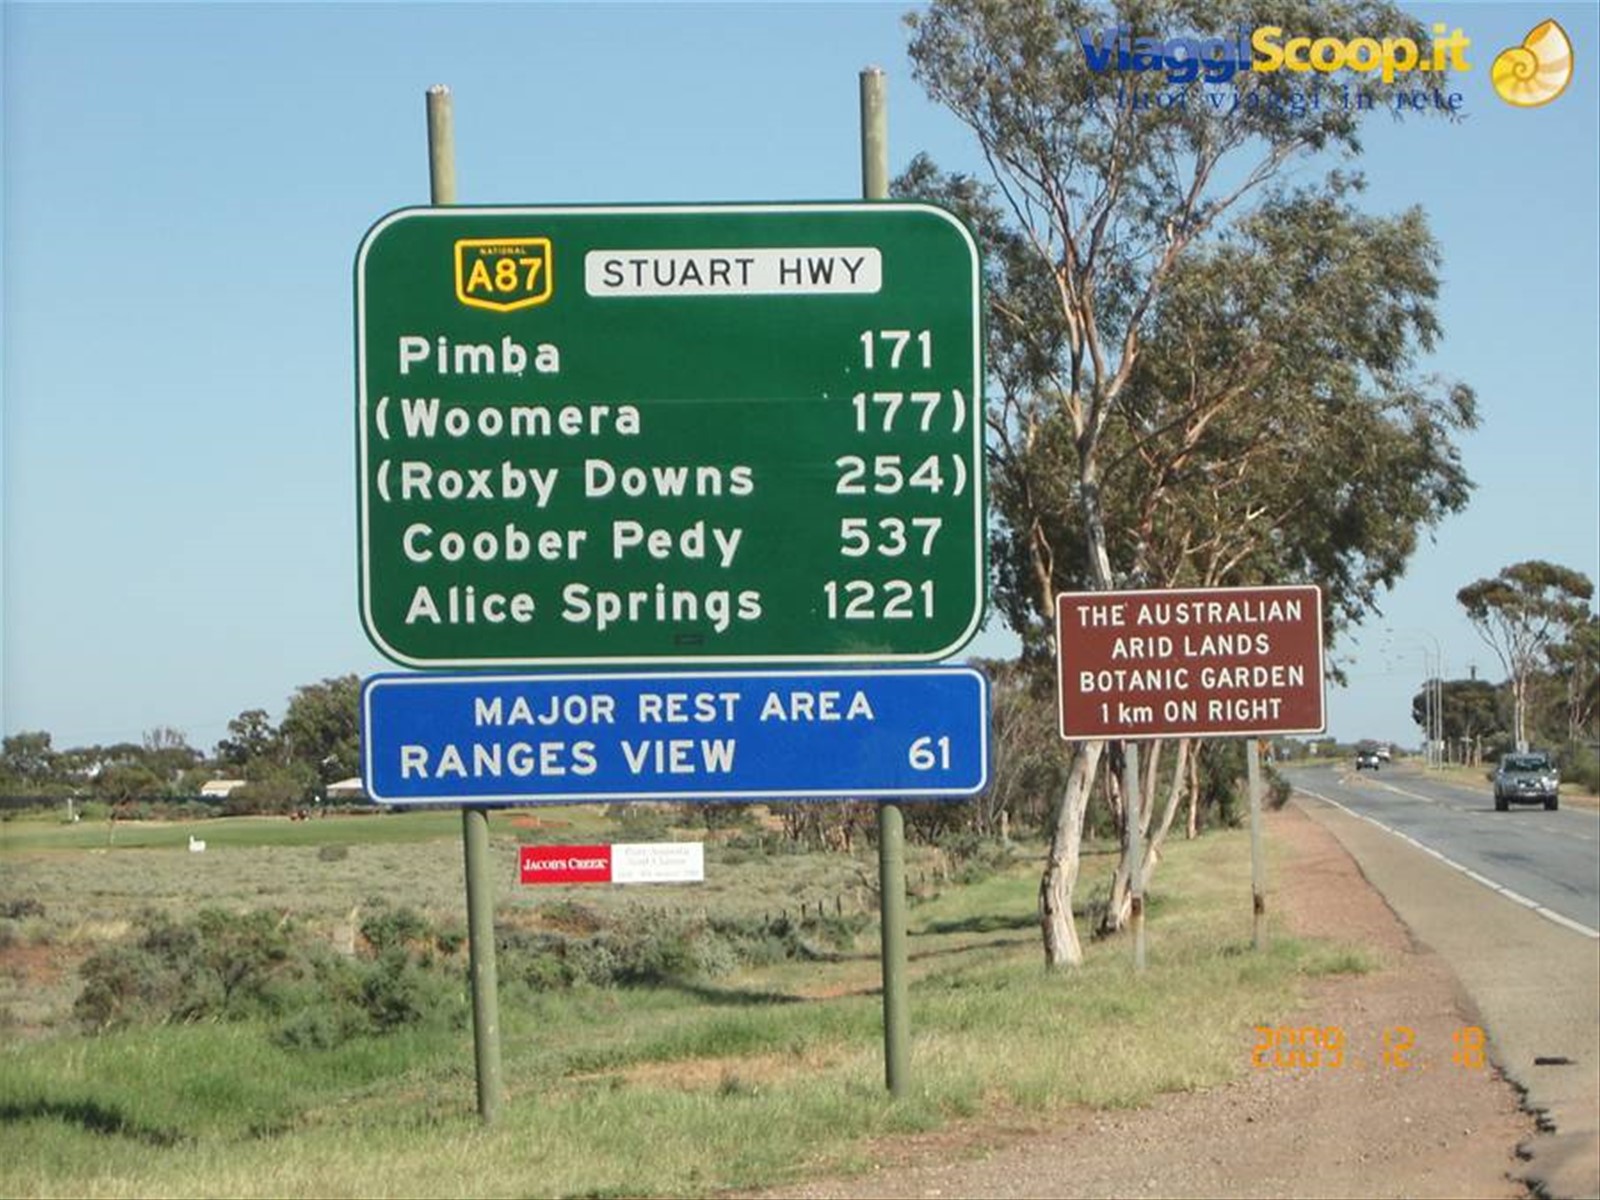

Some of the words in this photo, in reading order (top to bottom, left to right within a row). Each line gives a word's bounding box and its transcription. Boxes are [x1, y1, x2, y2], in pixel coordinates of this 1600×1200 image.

[479, 247, 527, 255] NATIONAL
[466, 258, 543, 292] A87
[604, 258, 754, 287] STUART
[780, 257, 864, 285] HWY
[399, 336, 560, 372] Pimba
[860, 330, 931, 369] 171
[375, 396, 640, 439] (Woomera
[852, 389, 966, 433] 177)
[377, 459, 559, 508] (Roxby
[585, 460, 754, 497] Downs
[836, 454, 967, 496] 254)
[403, 523, 587, 562] Coober
[613, 520, 742, 568] Pedy
[840, 517, 942, 557] 537
[405, 585, 535, 624] Alice
[562, 583, 762, 633] Springs
[824, 580, 933, 619] 1221
[1077, 605, 1125, 626] THE
[1137, 600, 1302, 625] AUSTRALIAN
[1111, 637, 1173, 660] ARID
[1184, 633, 1270, 657] LANDS
[1080, 668, 1189, 693] BOTANIC
[1201, 665, 1304, 689] GARDEN
[475, 695, 615, 726] MAJOR
[639, 693, 741, 723] REST
[760, 691, 874, 721] AREA
[1101, 703, 1109, 724] 1
[1118, 702, 1153, 723] km
[1164, 701, 1197, 722] ON
[1208, 698, 1282, 721] RIGHT
[401, 742, 597, 778] RANGES
[621, 739, 736, 774] VIEW
[909, 737, 950, 769] 61
